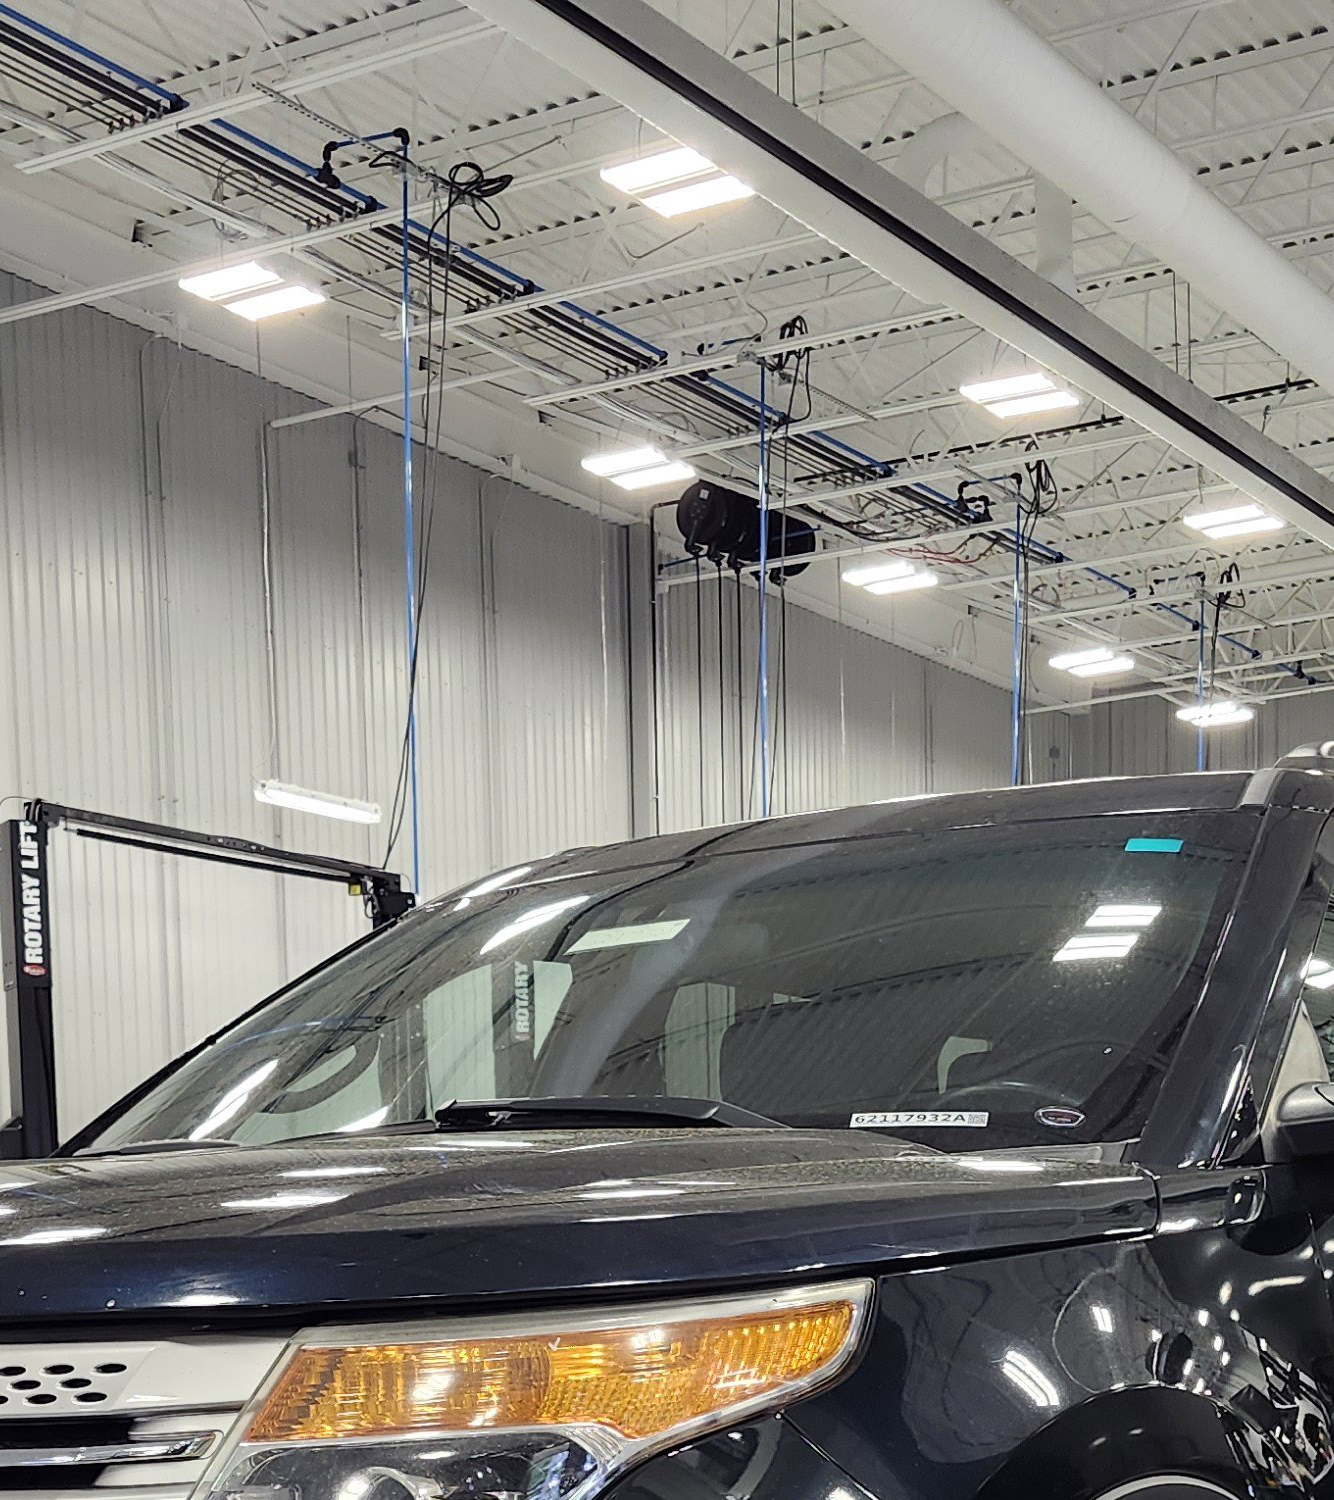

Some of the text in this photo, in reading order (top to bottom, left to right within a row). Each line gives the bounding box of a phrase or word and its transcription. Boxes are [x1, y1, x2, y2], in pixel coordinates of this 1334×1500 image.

[19, 821, 40, 870] LIFT
[21, 873, 44, 965] ROTARY
[515, 960, 530, 1033] ROTARY
